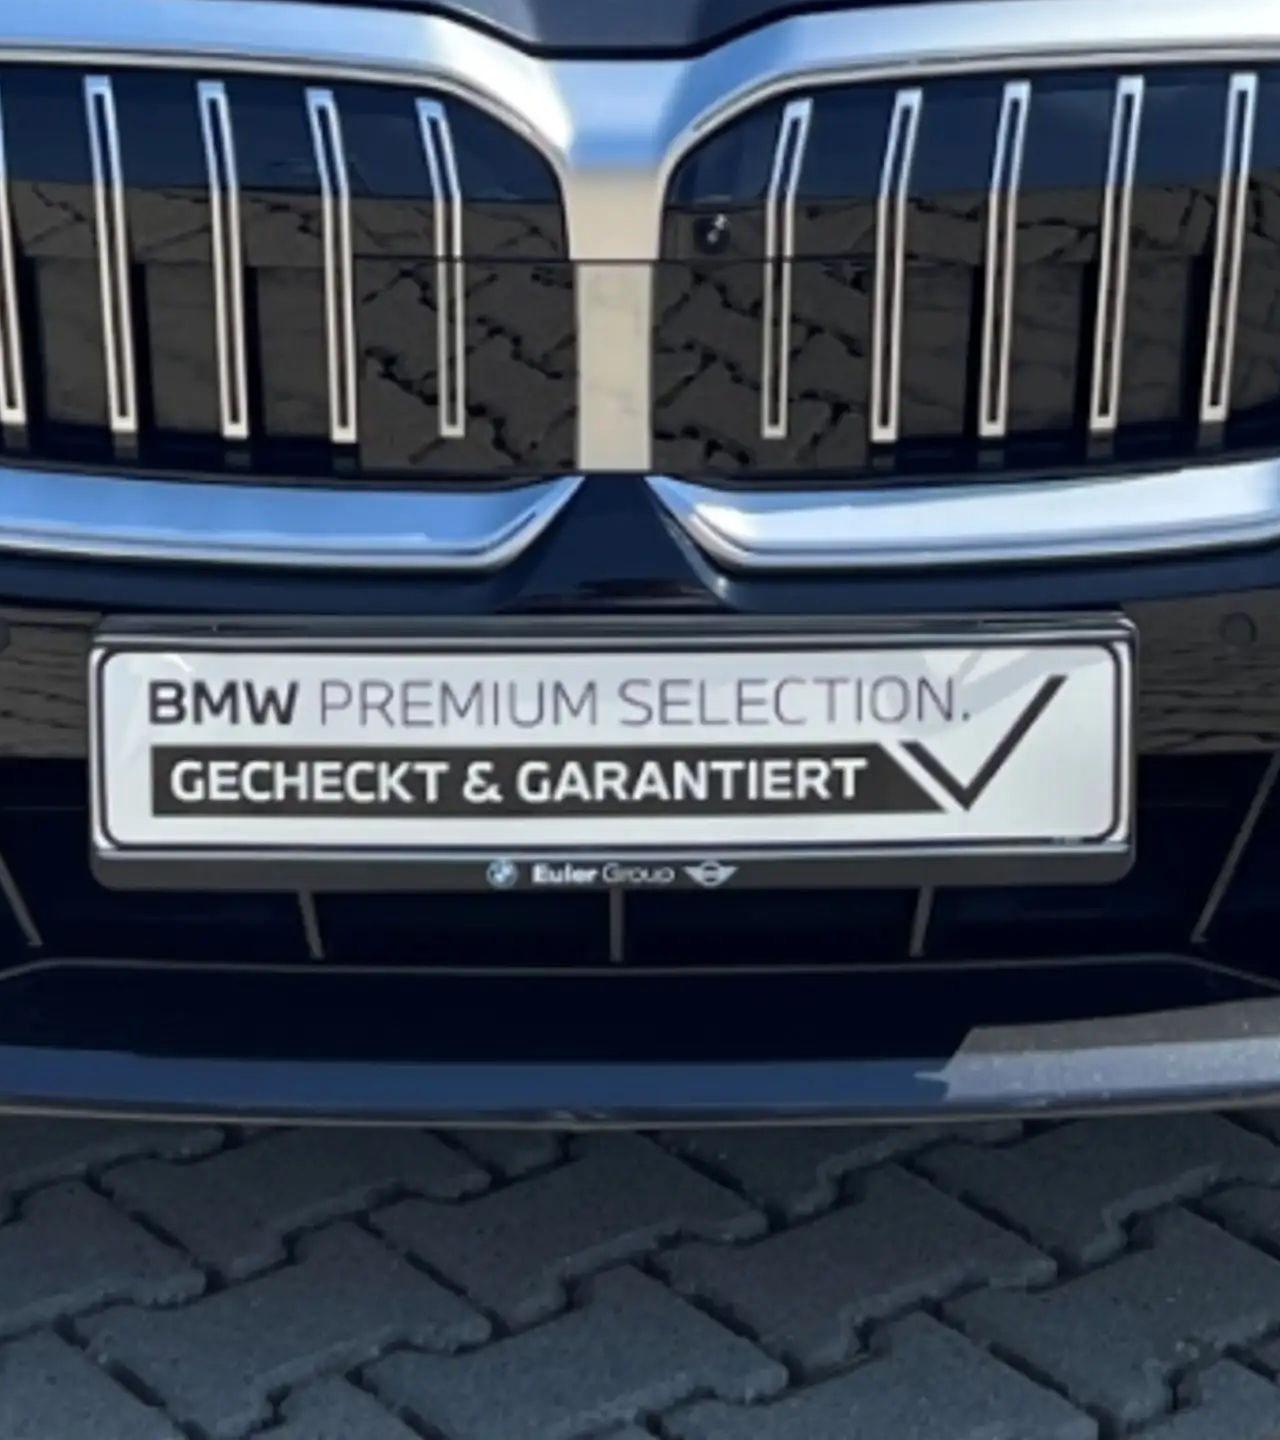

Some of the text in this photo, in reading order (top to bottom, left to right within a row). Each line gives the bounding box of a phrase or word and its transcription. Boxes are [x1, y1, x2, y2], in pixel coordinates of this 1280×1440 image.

[148, 675, 972, 728] BMW PREMIUM SELECTION.
[169, 757, 869, 803] GECHECKT & GARANTIERT
[532, 862, 676, 886] Euler Group
